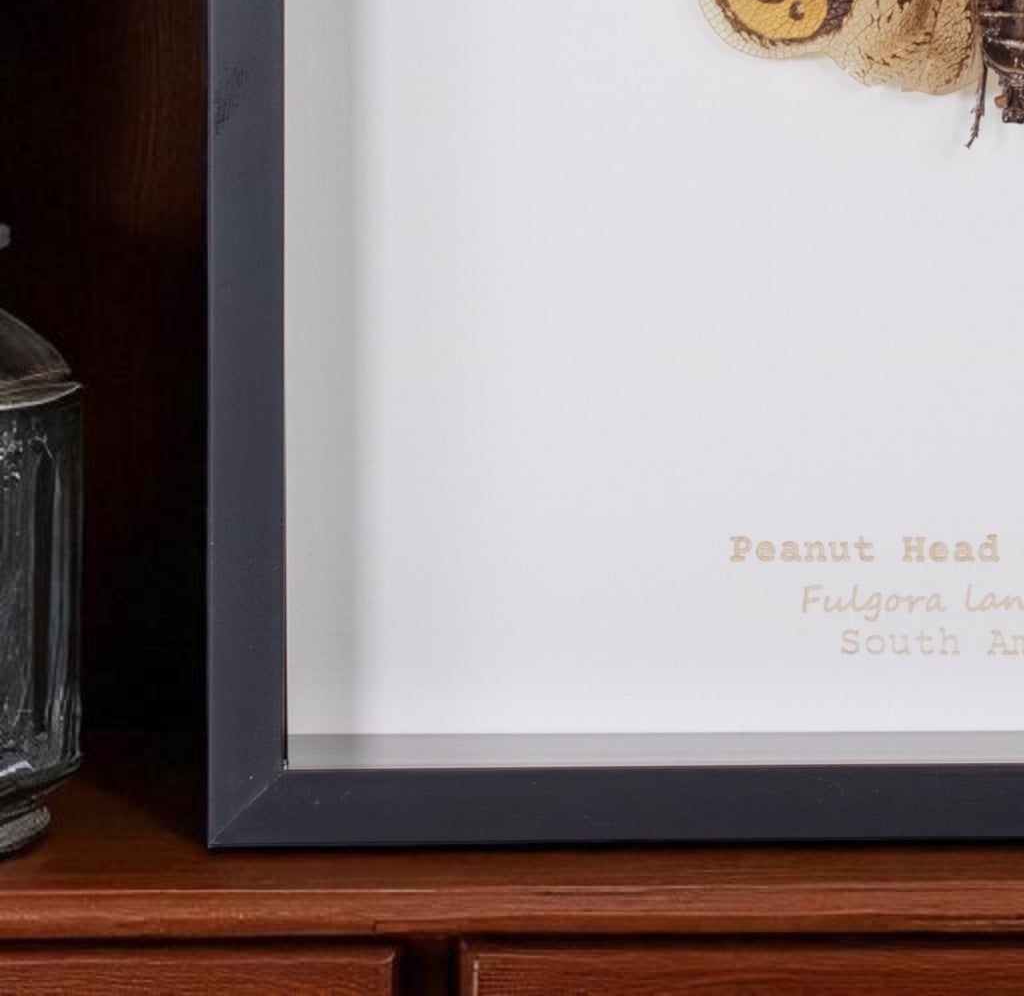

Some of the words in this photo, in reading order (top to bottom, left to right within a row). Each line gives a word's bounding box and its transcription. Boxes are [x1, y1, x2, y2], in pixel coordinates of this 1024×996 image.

[729, 535, 875, 563] Peanut
[902, 534, 1000, 563] Head
[801, 584, 946, 622] Fulgora
[840, 628, 960, 656] South
